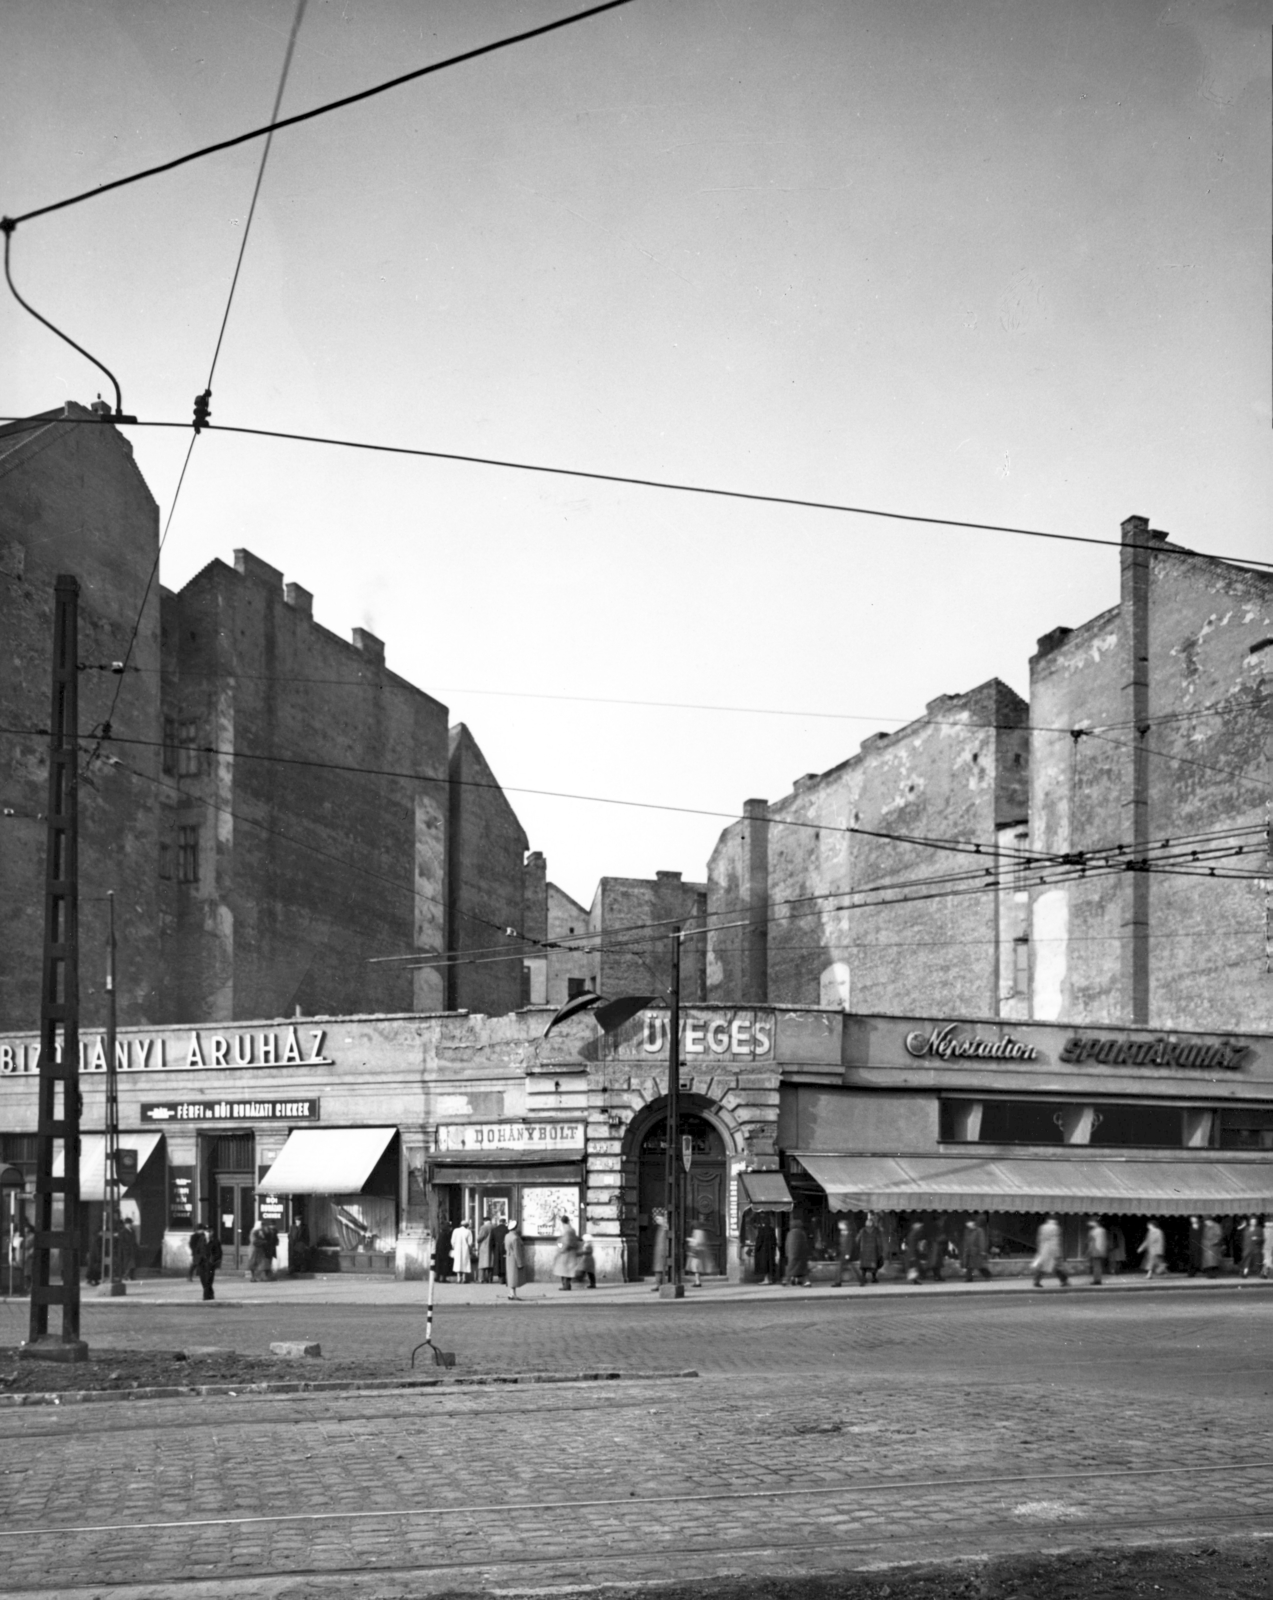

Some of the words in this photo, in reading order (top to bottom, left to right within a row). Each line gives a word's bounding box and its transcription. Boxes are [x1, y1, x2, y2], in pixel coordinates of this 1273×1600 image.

[1, 1035, 163, 1073] BIZÁNYI
[186, 1025, 324, 1067] ÁRUHÁZ
[643, 1013, 770, 1055] ÜVEGES
[906, 1022, 1038, 1060] Népstadion
[1058, 1037, 1251, 1070] SPORTÁRUHÁZ
[177, 1102, 204, 1119] FÉRFI
[214, 1101, 231, 1118] NŐI
[233, 1101, 273, 1118] RUHÁZATI
[275, 1101, 310, 1117] CIKKEK
[474, 1124, 578, 1144] DOHÁNYBOLT
